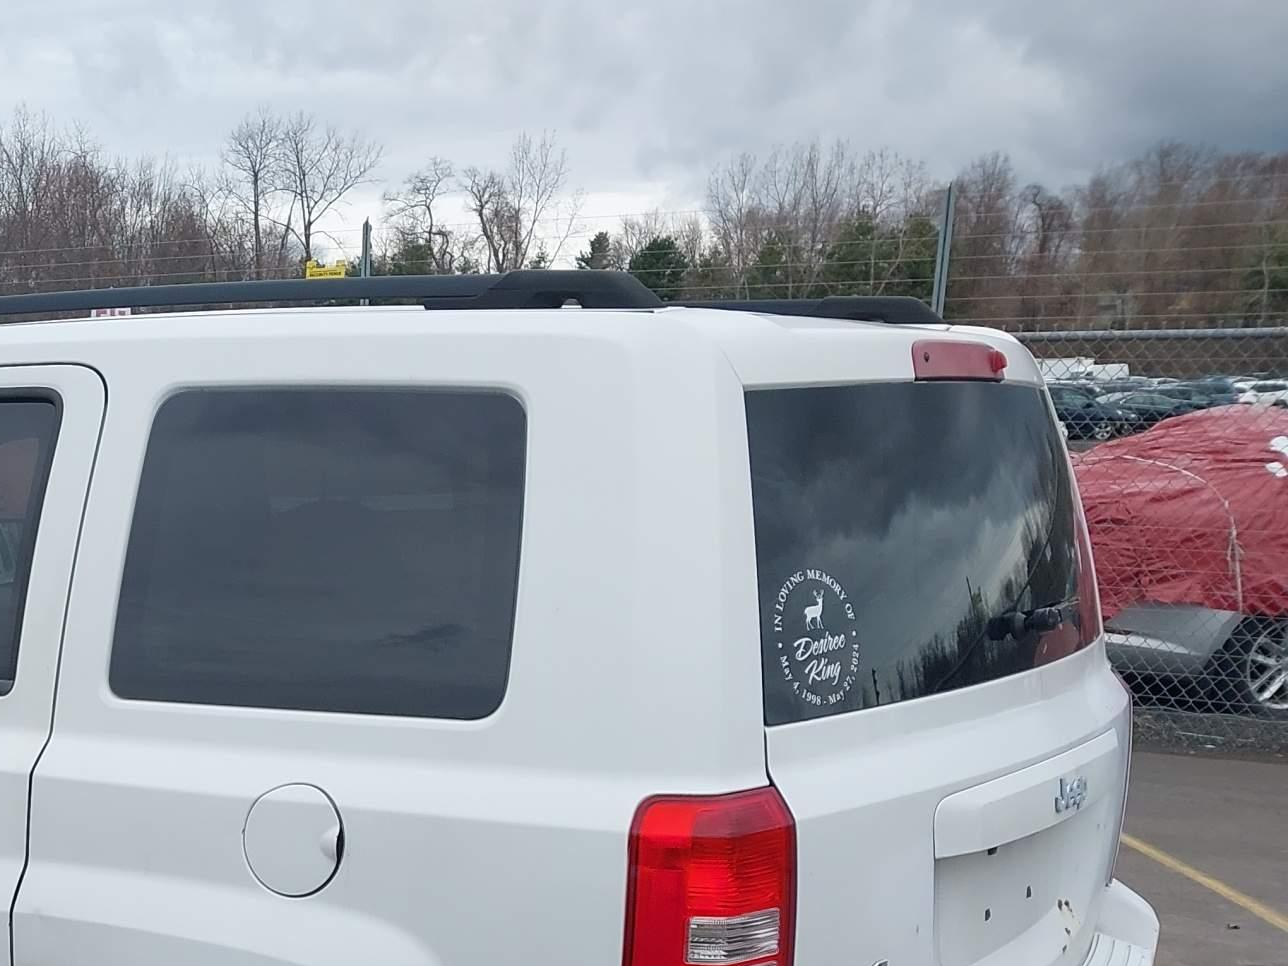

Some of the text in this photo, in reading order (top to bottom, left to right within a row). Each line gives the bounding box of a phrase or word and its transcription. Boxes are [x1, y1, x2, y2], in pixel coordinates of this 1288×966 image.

[774, 569, 856, 632] IN LOVING MEMORY OF
[793, 631, 846, 661] Desiree
[780, 655, 793, 680] May
[801, 688, 822, 706] 1998
[828, 689, 845, 705] May
[804, 657, 841, 686] King
